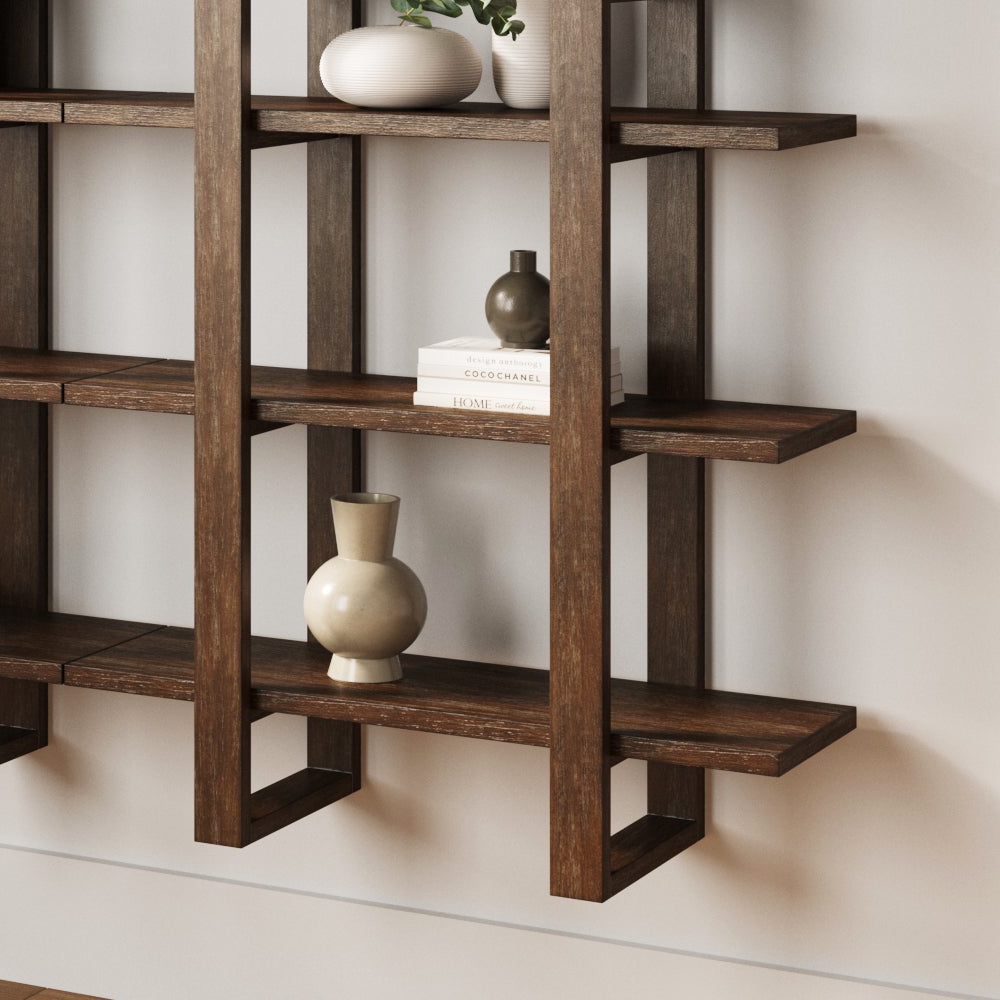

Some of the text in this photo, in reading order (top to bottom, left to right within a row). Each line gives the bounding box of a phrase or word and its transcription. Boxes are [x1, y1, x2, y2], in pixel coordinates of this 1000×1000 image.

[466, 355, 496, 366] design
[465, 370, 541, 382] COCOCHANEL
[453, 397, 492, 409] HOME
